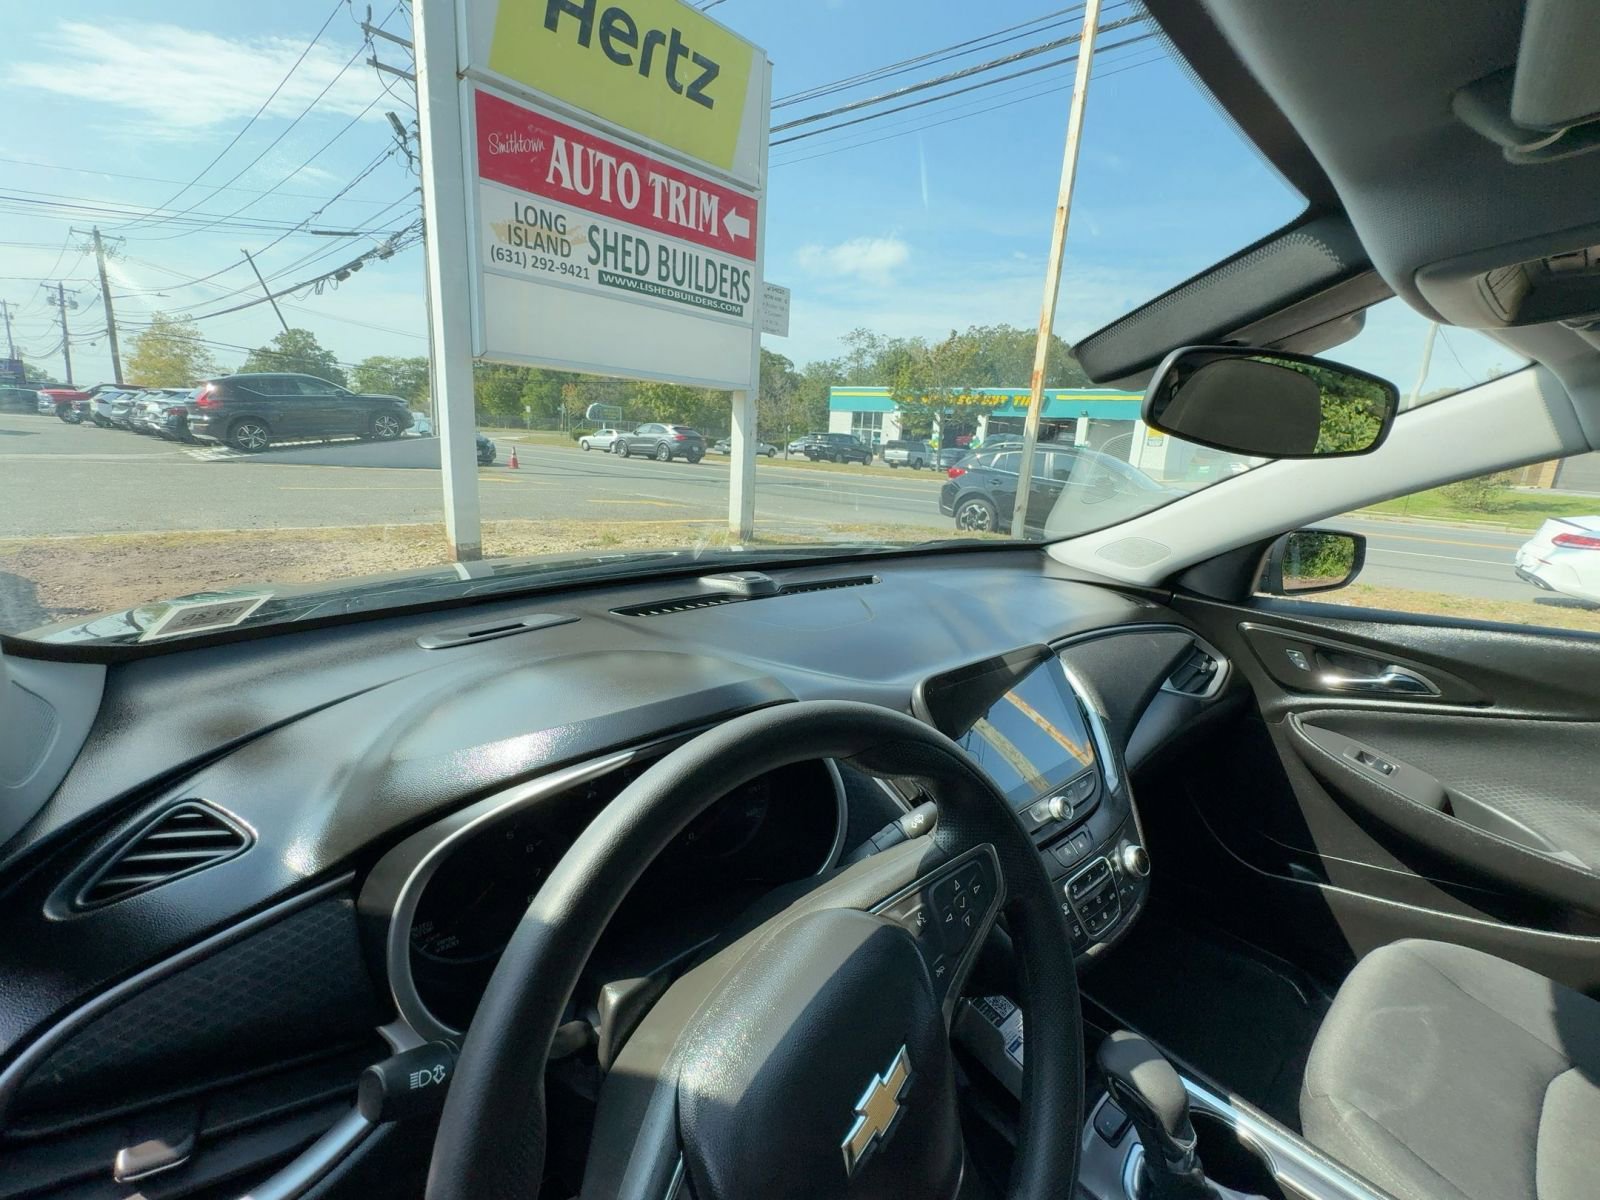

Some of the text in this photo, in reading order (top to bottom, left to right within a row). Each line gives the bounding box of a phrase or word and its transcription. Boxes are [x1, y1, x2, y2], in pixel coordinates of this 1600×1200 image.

[543, 0, 720, 110] Hertz
[488, 130, 720, 237] Smithtown AUTO TRIM
[514, 201, 567, 235] LONG
[490, 244, 590, 280] (631) 292-9421
[507, 224, 572, 258] ISLAND
[587, 224, 751, 304] SHED BUILDERS
[602, 273, 742, 315] WWW.LISHEDBUILDERS.COM
